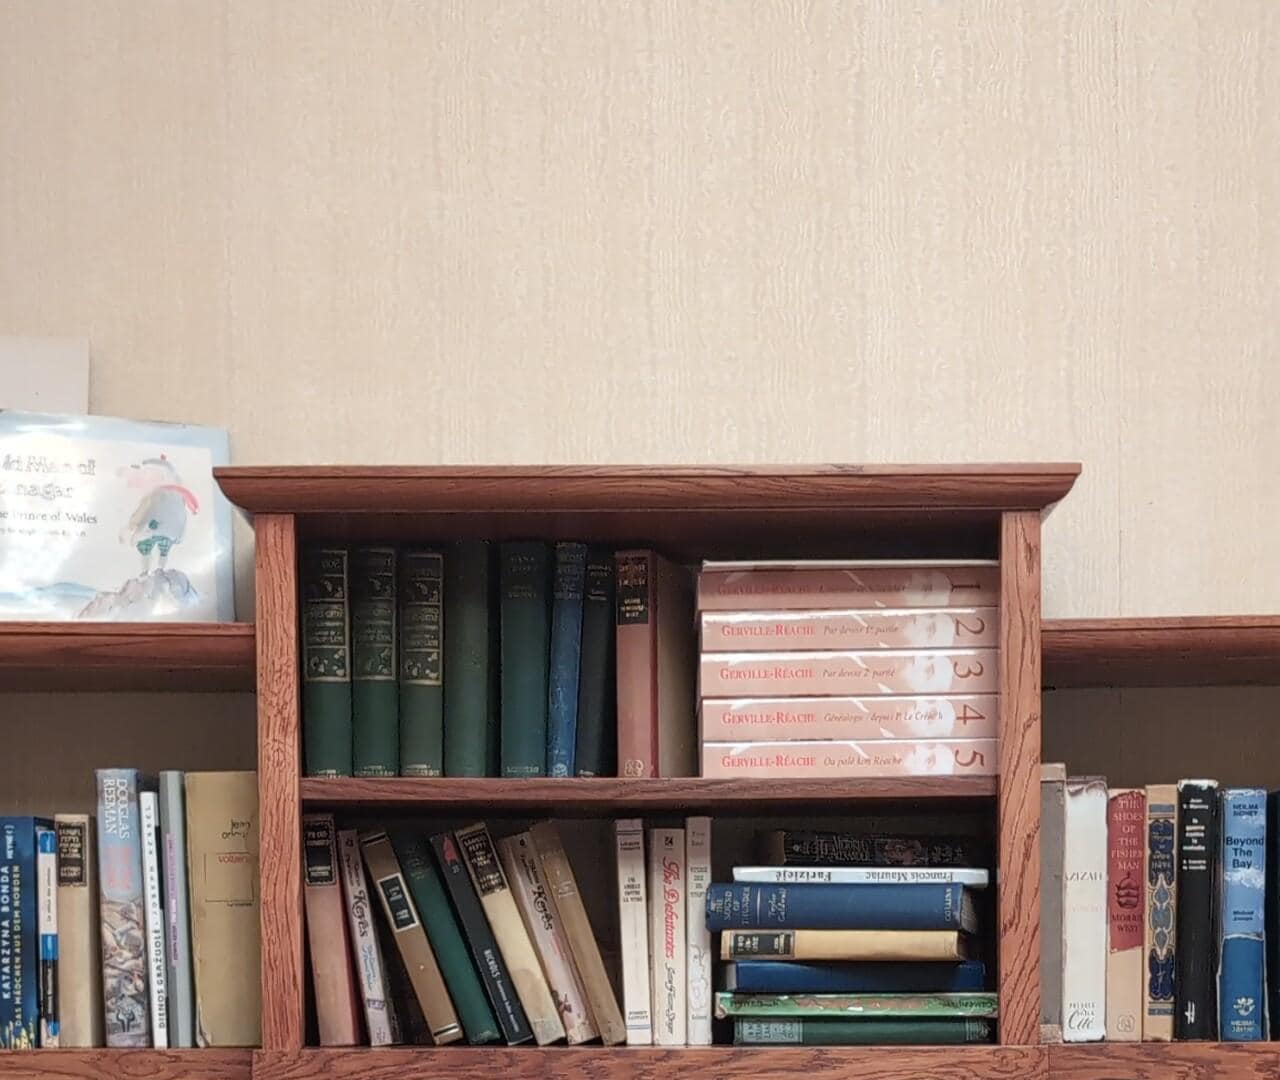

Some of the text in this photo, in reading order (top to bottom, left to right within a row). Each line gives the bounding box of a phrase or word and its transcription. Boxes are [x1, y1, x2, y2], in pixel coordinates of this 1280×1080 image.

[78, 459, 96, 476] of
[50, 510, 62, 523] of
[66, 512, 98, 525] Wales
[955, 617, 985, 636] 2
[953, 660, 984, 679] 3
[956, 704, 986, 725] 4
[954, 749, 985, 768] 5
[104, 779, 117, 834] REEMAN
[117, 779, 130, 840] DOUGLAS
[1119, 800, 1140, 809] THE
[1113, 812, 1144, 821] SHOES
[1122, 825, 1136, 834] OF
[1119, 838, 1138, 846] THE
[1226, 836, 1265, 847] Beyond
[1232, 847, 1253, 857] The
[662, 857, 681, 886] The
[1118, 861, 1140, 870] MAN
[1232, 859, 1253, 869] Bay
[12, 865, 20, 907] NORDEN
[865, 871, 908, 882] Mauriac
[351, 888, 370, 938] Keyes
[532, 884, 554, 932] Keyes
[723, 890, 733, 921] SOUND
[732, 900, 740, 912] OF
[944, 888, 953, 922] COLLINS
[13, 910, 21, 932] DEM
[663, 886, 681, 960] Debutantes
[1117, 924, 1138, 934] WEST
[0, 866, 12, 1000] KATARZYNA BONDA
[13, 934, 21, 954] AUS
[13, 957, 22, 1004] MÄDCHEN
[156, 989, 166, 1029] DIENOS
